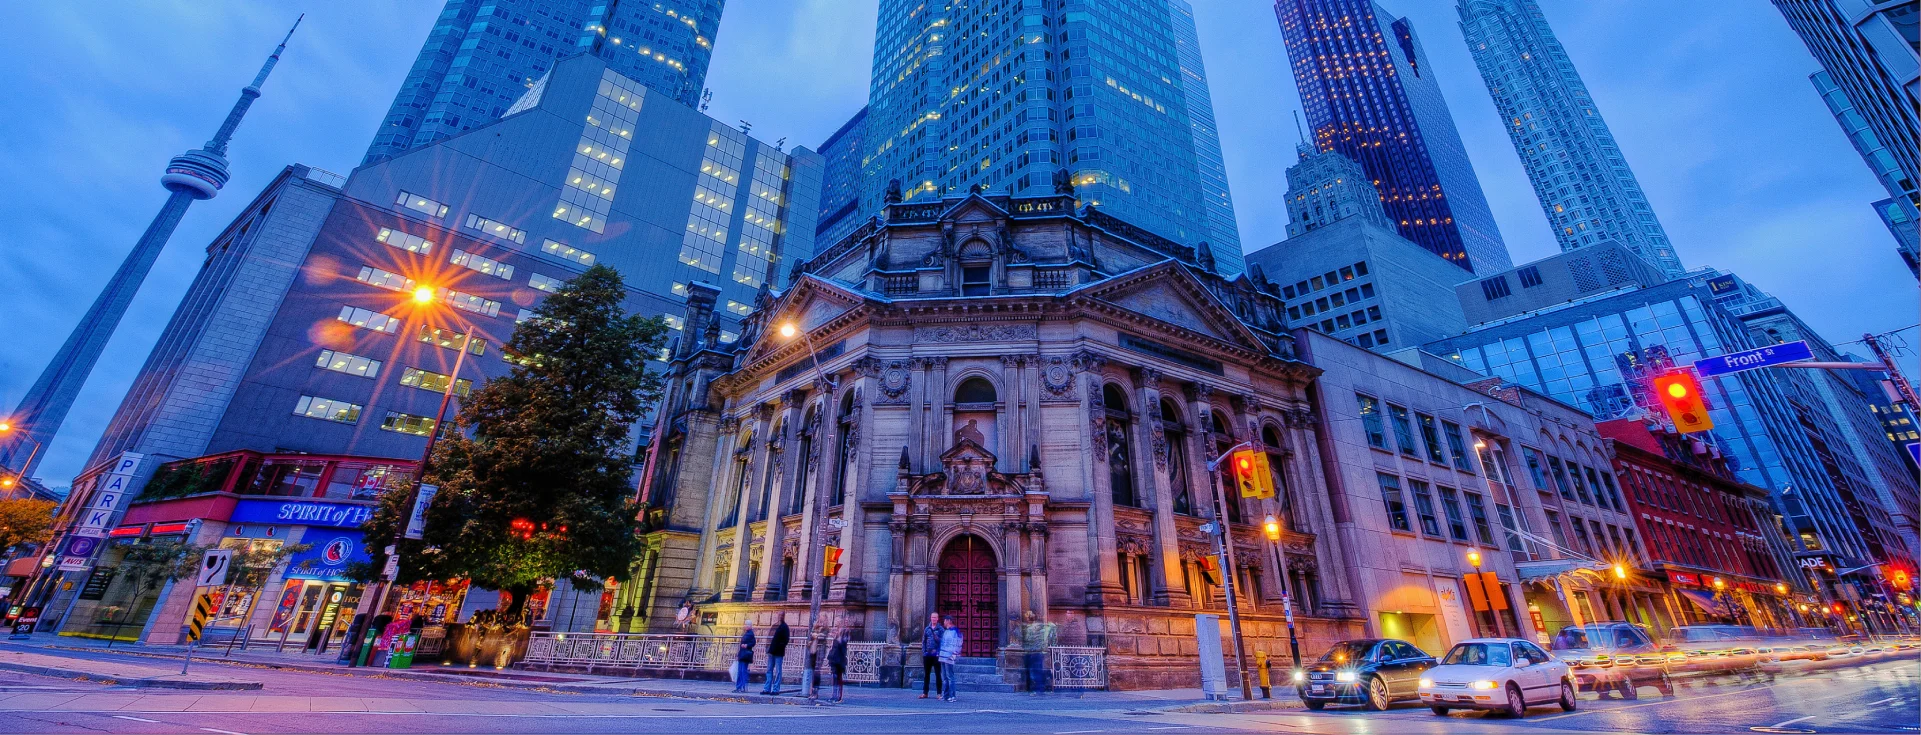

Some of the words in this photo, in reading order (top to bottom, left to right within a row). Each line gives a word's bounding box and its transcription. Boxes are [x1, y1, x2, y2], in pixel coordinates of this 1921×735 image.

[1724, 351, 1766, 368] Front
[1764, 348, 1775, 356] St
[90, 459, 134, 526] PARK
[278, 503, 336, 521] SPIRIT
[333, 507, 354, 526] of
[291, 566, 318, 575] SPIRIT
[318, 568, 326, 577] of
